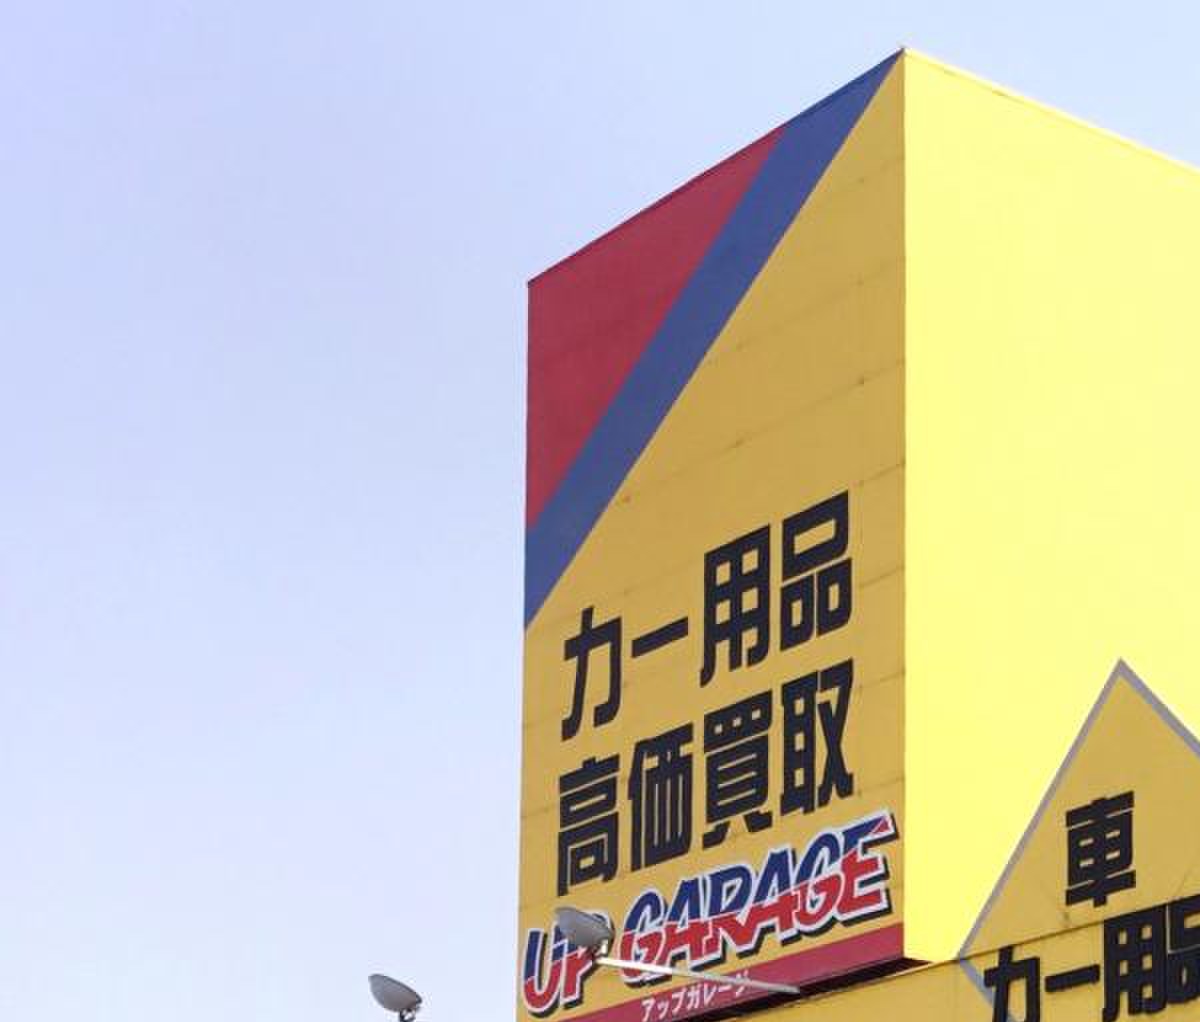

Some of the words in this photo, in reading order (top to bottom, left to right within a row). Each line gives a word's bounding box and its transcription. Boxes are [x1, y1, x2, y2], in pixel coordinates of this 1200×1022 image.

[561, 490, 853, 741] カー用品
[557, 658, 854, 896] 高価買取
[1065, 790, 1136, 907] 車
[619, 810, 894, 985] GARAGE
